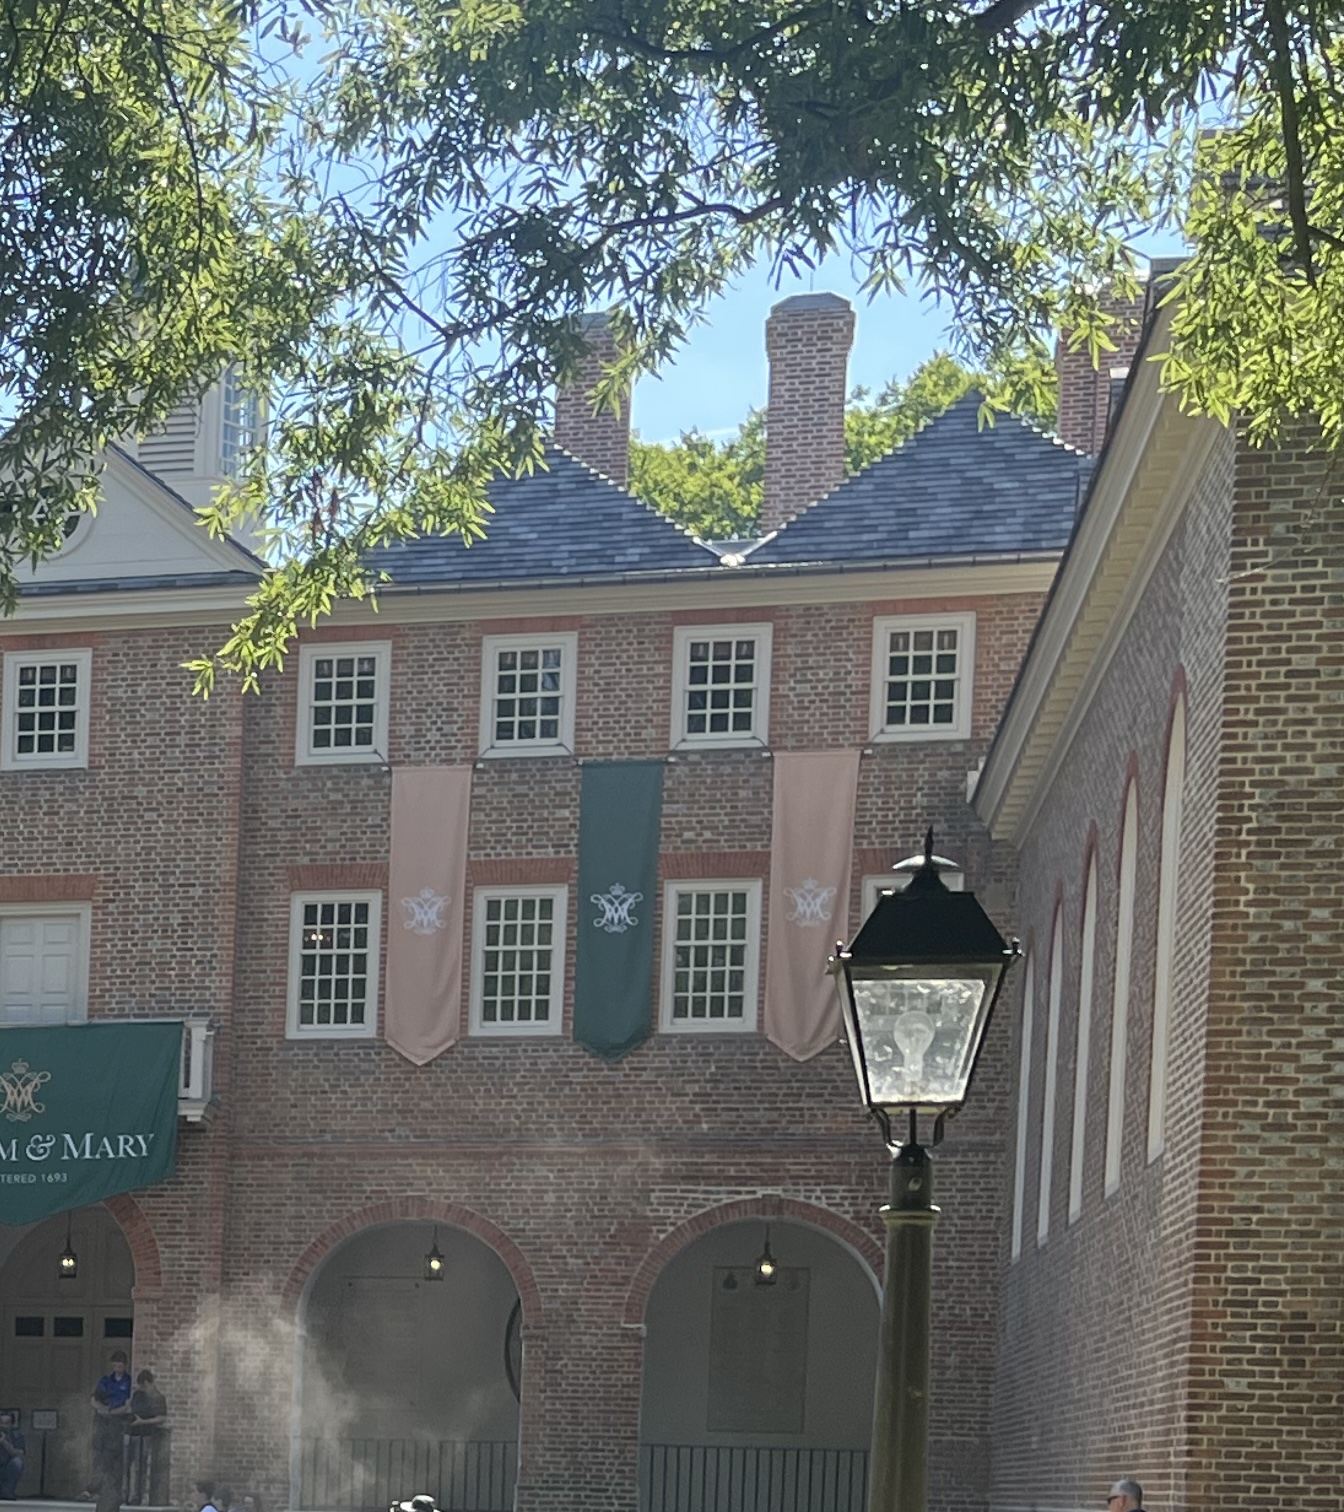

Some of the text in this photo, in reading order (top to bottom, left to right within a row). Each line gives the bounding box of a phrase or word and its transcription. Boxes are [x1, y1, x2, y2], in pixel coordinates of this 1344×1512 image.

[25, 1134, 56, 1161] &
[60, 1131, 155, 1160] MARY
[40, 1172, 68, 1183] 1693
